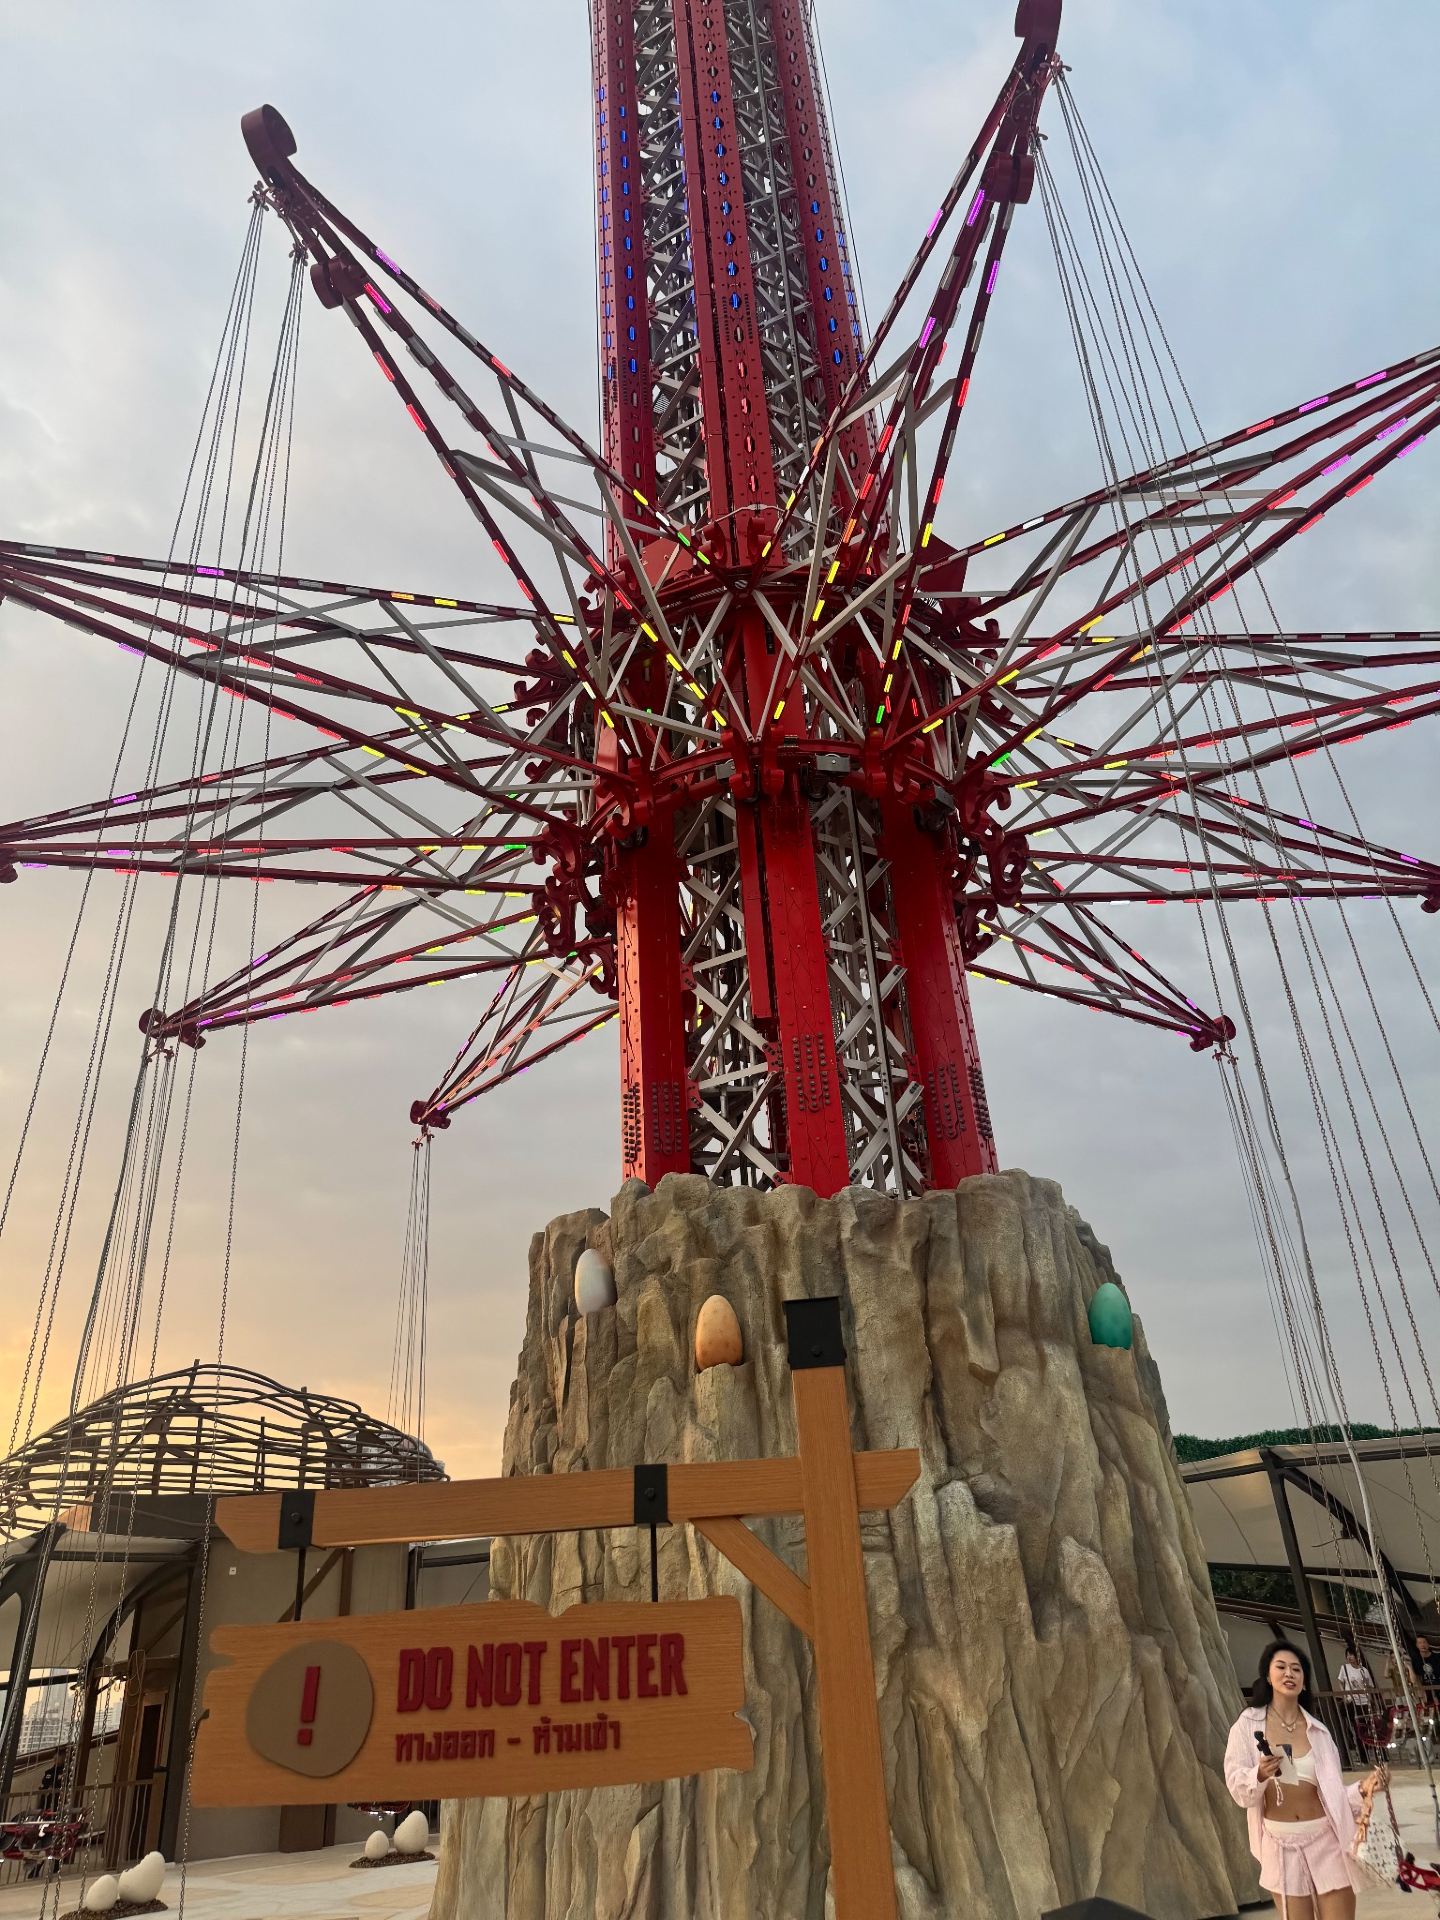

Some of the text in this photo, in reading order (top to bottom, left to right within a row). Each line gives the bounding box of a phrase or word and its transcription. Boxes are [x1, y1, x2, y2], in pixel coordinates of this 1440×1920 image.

[396, 1632, 688, 1713] DO NOT ENTER
[395, 1729, 495, 1763] ทางออก
[533, 1713, 621, 1755] ห้ามเข้า
